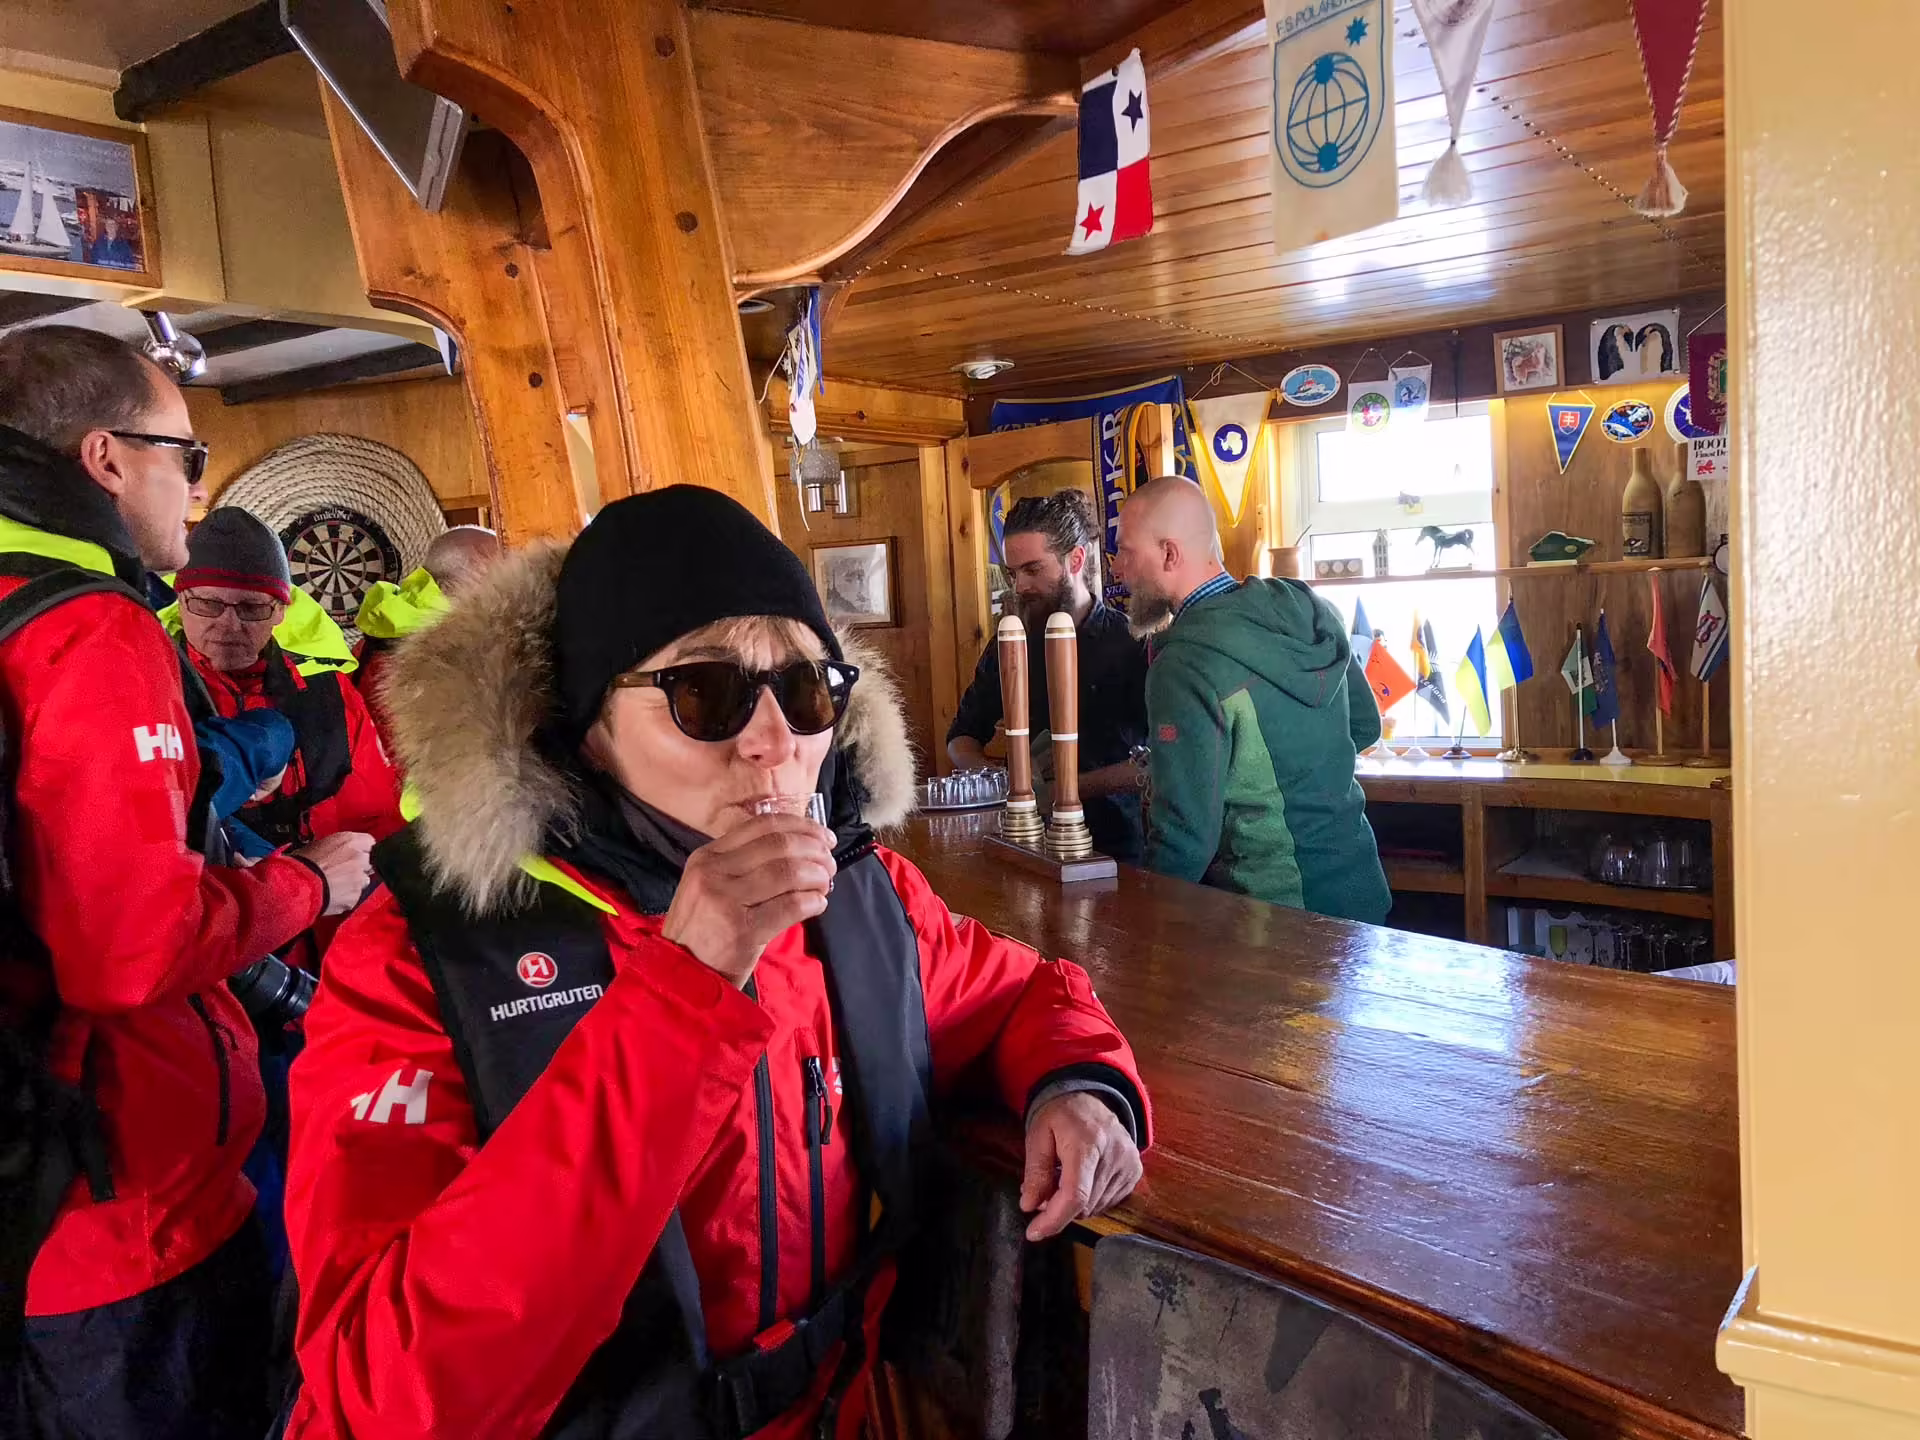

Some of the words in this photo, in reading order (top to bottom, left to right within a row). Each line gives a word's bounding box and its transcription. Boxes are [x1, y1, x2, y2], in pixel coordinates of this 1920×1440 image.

[1693, 437, 1728, 451] BOOT
[132, 723, 185, 762] HH
[490, 984, 604, 1021] HURTIGRUTEN
